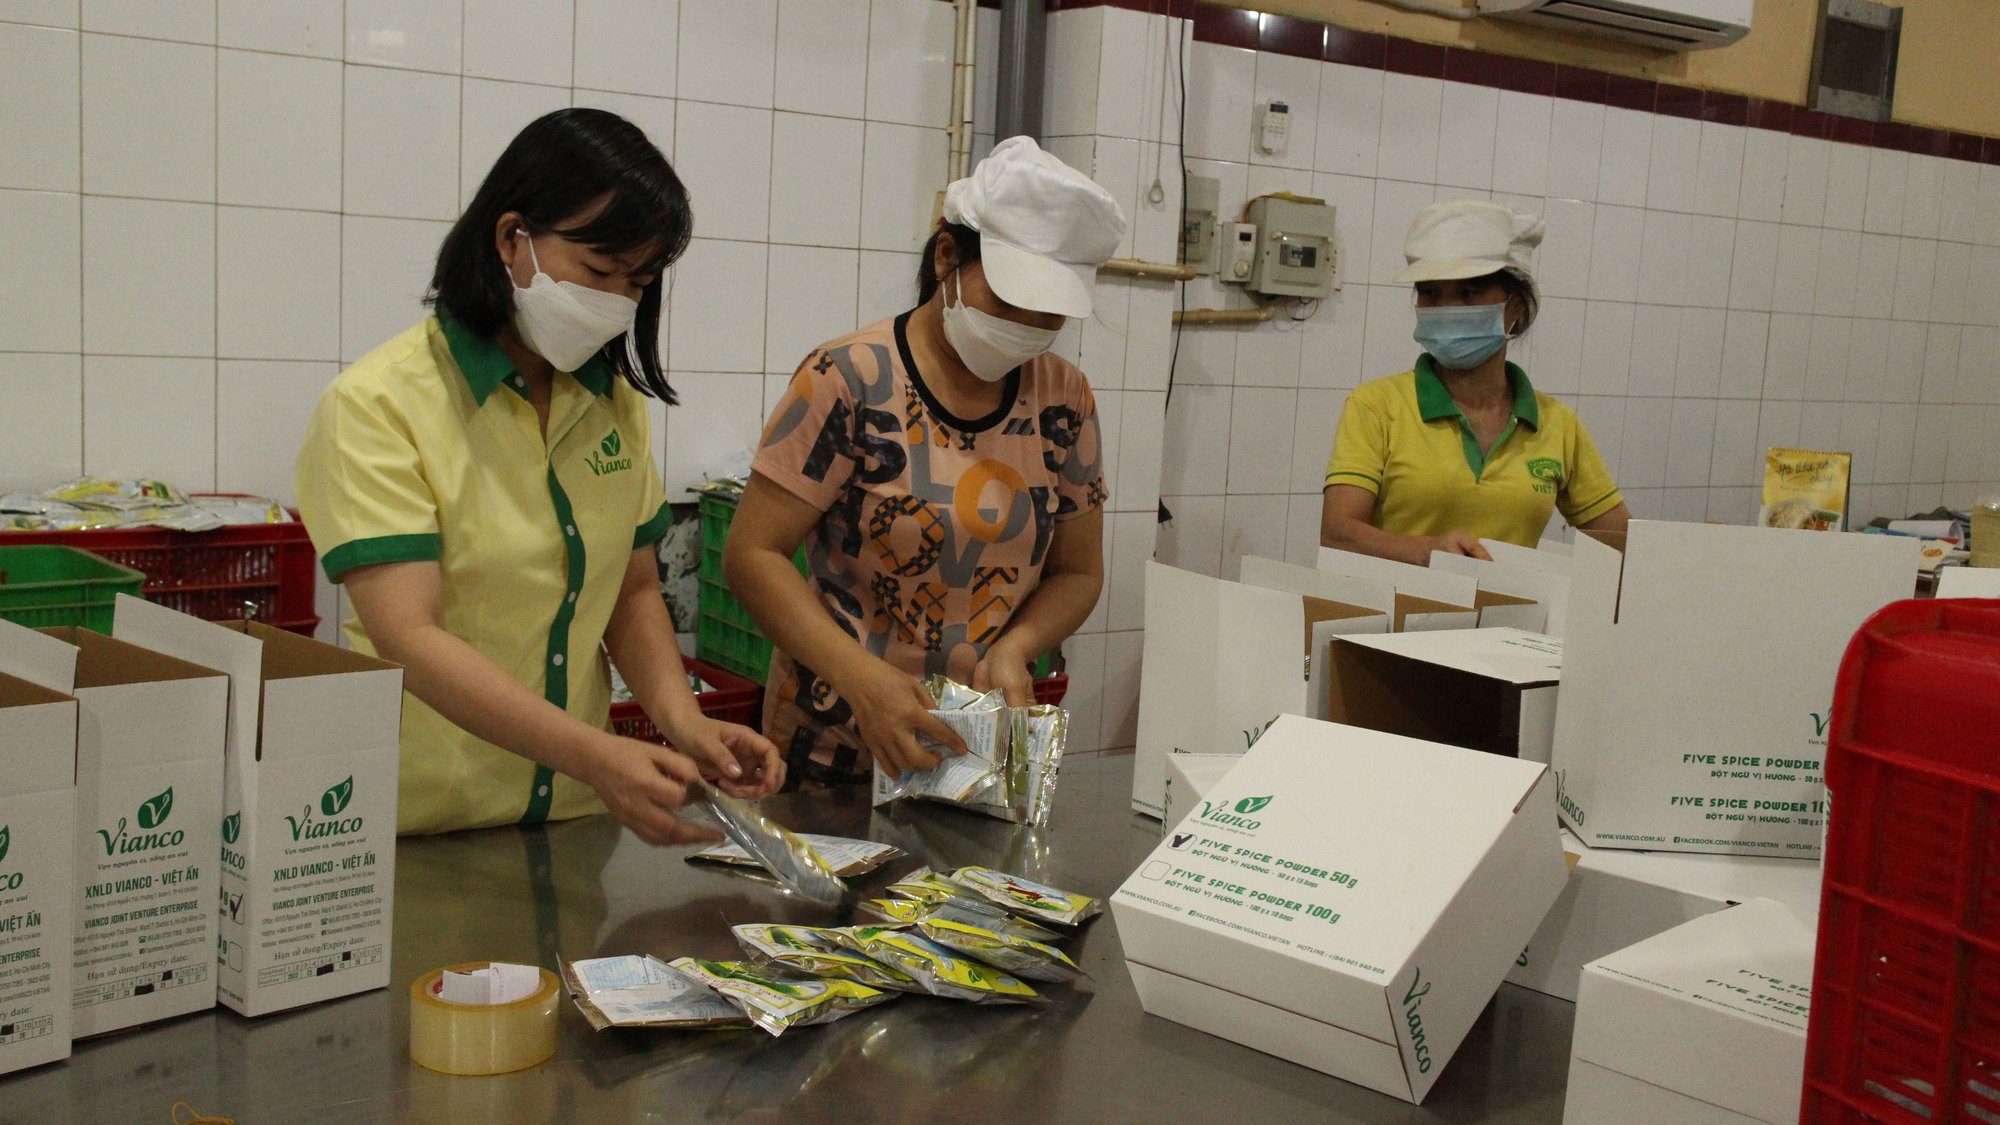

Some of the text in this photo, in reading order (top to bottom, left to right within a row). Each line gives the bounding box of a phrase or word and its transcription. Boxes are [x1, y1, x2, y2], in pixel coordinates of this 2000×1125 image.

[584, 450, 632, 476] Vianco
[1682, 753, 1820, 770] FIVE SPICE POWDER
[1555, 769, 1585, 827] Vianco
[1671, 796, 1704, 807] FIVE
[1709, 798, 1748, 809] SPICE
[1753, 800, 1807, 813] POWDER
[284, 804, 363, 842] Vianco
[1200, 800, 1261, 830] Vianco
[96, 816, 185, 857] Vianco
[1595, 833, 1666, 843] WWW.VIANCO.COM.AU
[273, 866, 298, 883] XNLD
[300, 860, 334, 878] VIANCO
[342, 854, 361, 871] VIỆT
[1199, 838, 1232, 853] FIVE
[1233, 847, 1273, 864] SPICE
[1275, 858, 1328, 879] POWDER
[85, 882, 113, 899] XNLD
[115, 874, 152, 894] VIANCO
[161, 868, 184, 887] VIỆT
[272, 884, 375, 911] VIANCO JOINT VENTURE ENTERPRISE
[1172, 868, 1206, 883] FIVE
[1207, 878, 1247, 895] SPICE
[1249, 890, 1303, 912] POWDER
[84, 917, 109, 929] VIANCO
[110, 912, 129, 927] JOINT
[129, 906, 159, 921] VENTURE
[160, 899, 198, 916] ENTERPRISE
[1119, 888, 1183, 912] WWW.VIANCO.COM.AU
[1705, 978, 1810, 1013] FIVE SPICE
[1403, 966, 1432, 1074] Vianco
